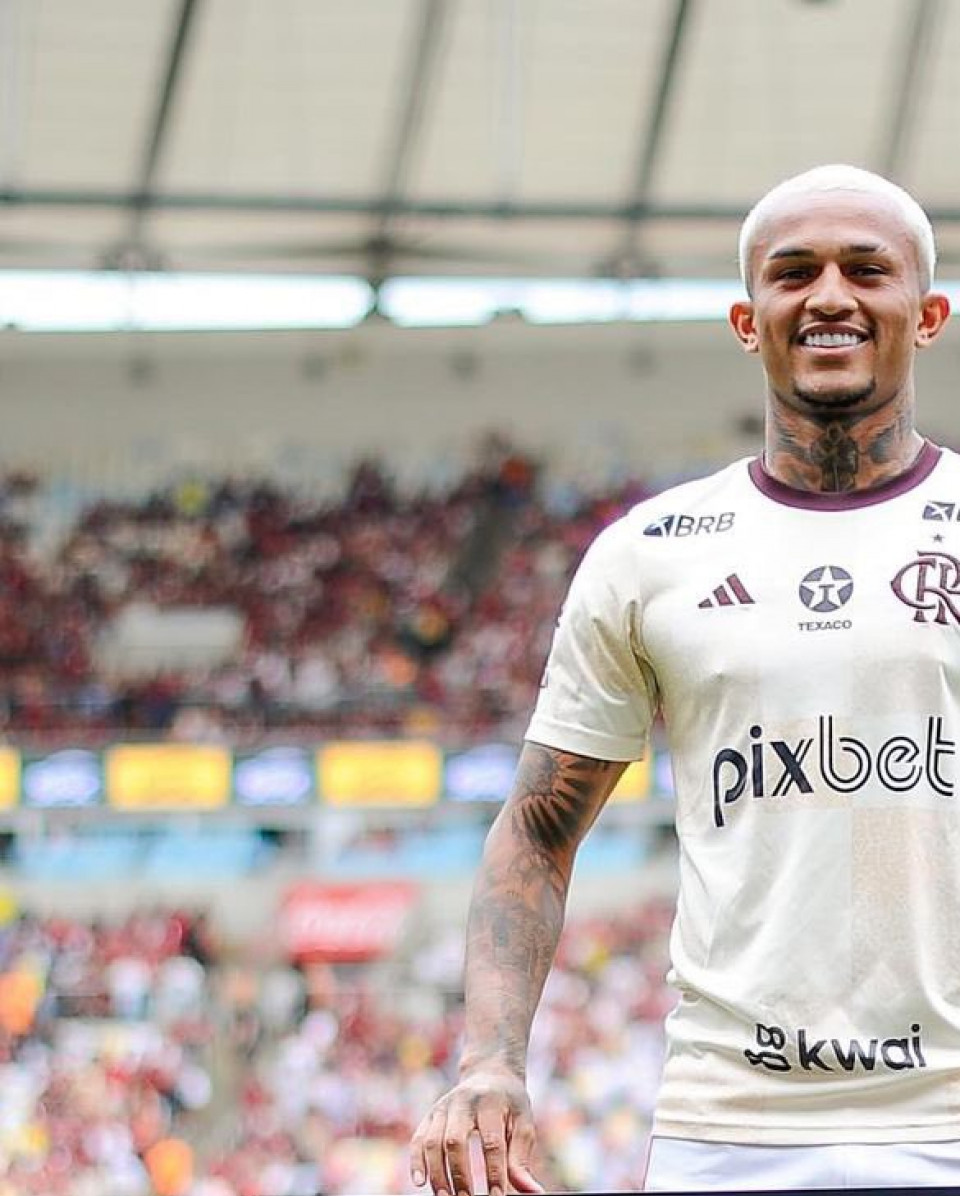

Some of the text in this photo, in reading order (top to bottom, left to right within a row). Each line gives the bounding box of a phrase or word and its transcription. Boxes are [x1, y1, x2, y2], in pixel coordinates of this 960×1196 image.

[674, 511, 736, 538] BRB
[798, 620, 853, 632] TEXACO
[713, 716, 955, 828] pixbet
[797, 1023, 926, 1071] kwai
